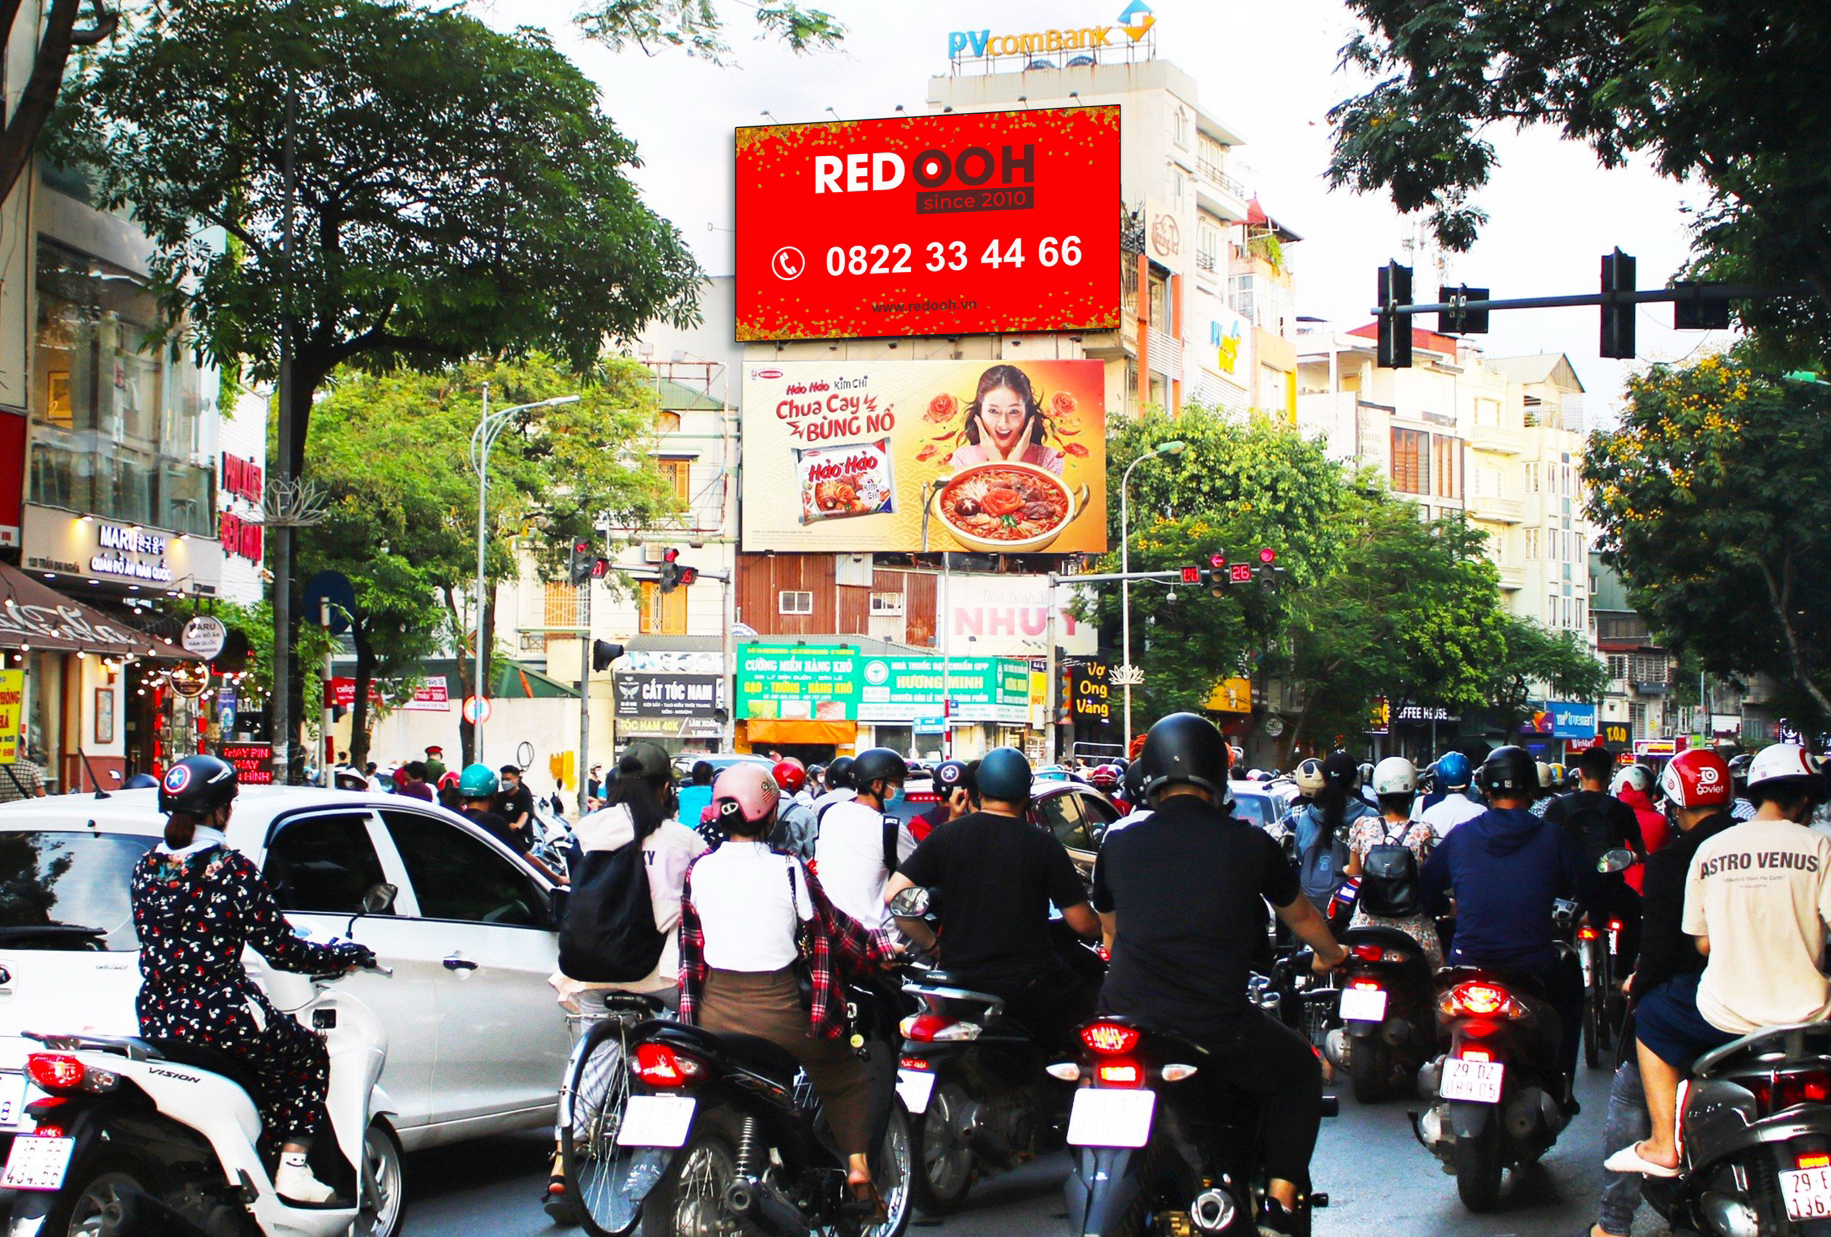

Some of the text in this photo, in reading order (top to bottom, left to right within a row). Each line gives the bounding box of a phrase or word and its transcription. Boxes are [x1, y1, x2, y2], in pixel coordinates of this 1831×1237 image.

[948, 26, 1113, 59] PVcomBank
[814, 144, 1035, 194] RED OOH
[924, 190, 1026, 211] since 2010
[826, 235, 1083, 278] 0822 33 44 66
[871, 299, 977, 314] www.redooh.vn
[775, 394, 860, 421] Chua Cay
[806, 404, 895, 442] BÙNG NỔ
[99, 526, 137, 551] MARU
[1233, 565, 1250, 580] 26
[1086, 661, 1106, 680] Vợ
[642, 677, 713, 701] CẮT TÓC NAM
[948, 676, 984, 689] MINH
[1080, 680, 1108, 699] Ong
[620, 718, 679, 732] TÓC NAM 40K
[1696, 783, 1724, 796] goviet
[1700, 851, 1818, 880] ASTRO VENUS
[148, 1067, 201, 1084] VISION
